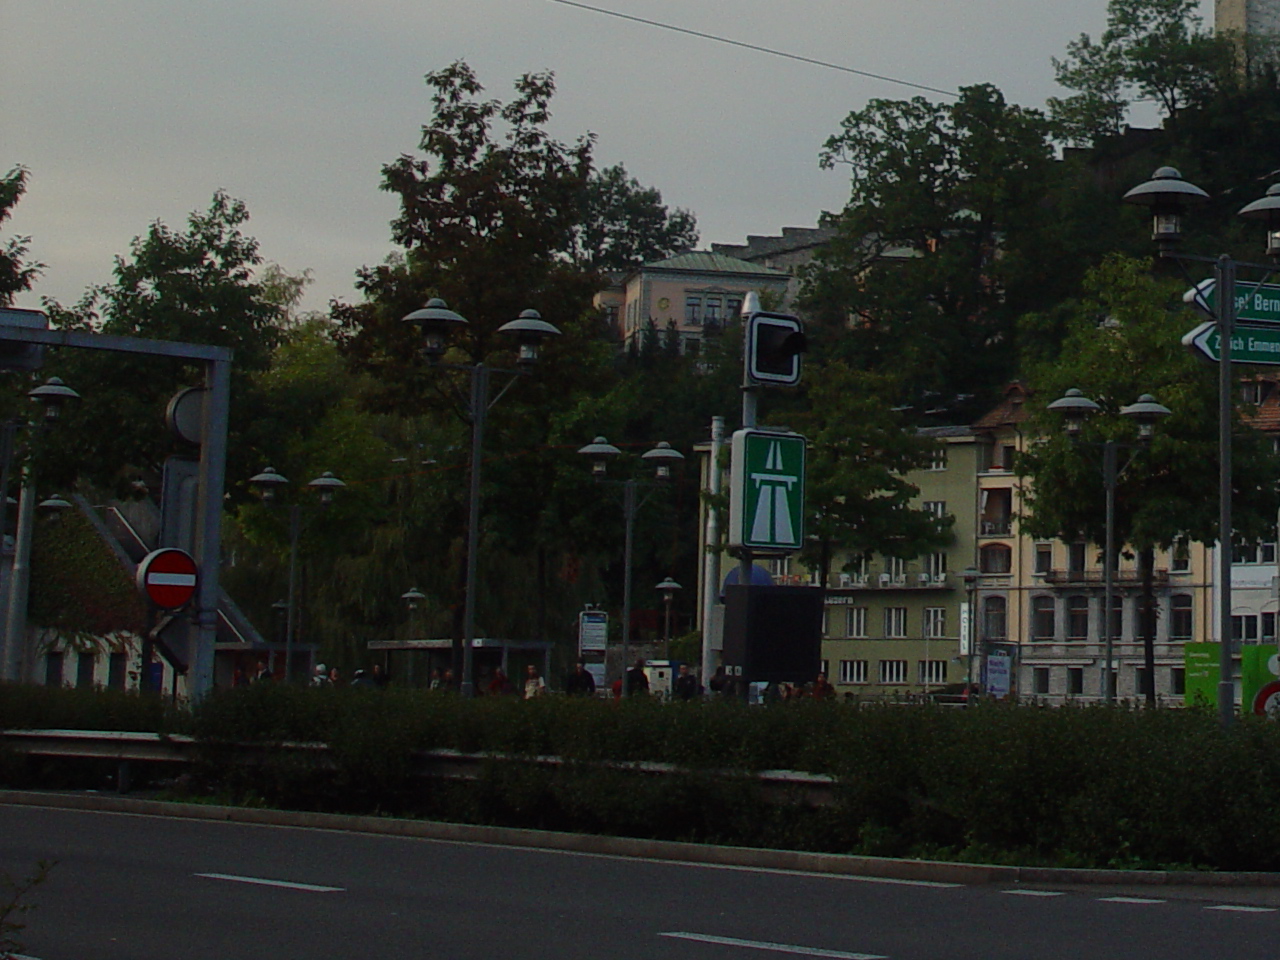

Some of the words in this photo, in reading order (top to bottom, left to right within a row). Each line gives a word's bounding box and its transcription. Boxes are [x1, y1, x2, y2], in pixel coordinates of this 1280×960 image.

[1254, 293, 1280, 312] Bern
[1214, 334, 1245, 351] Zich
[1248, 337, 1280, 354] Emmen
